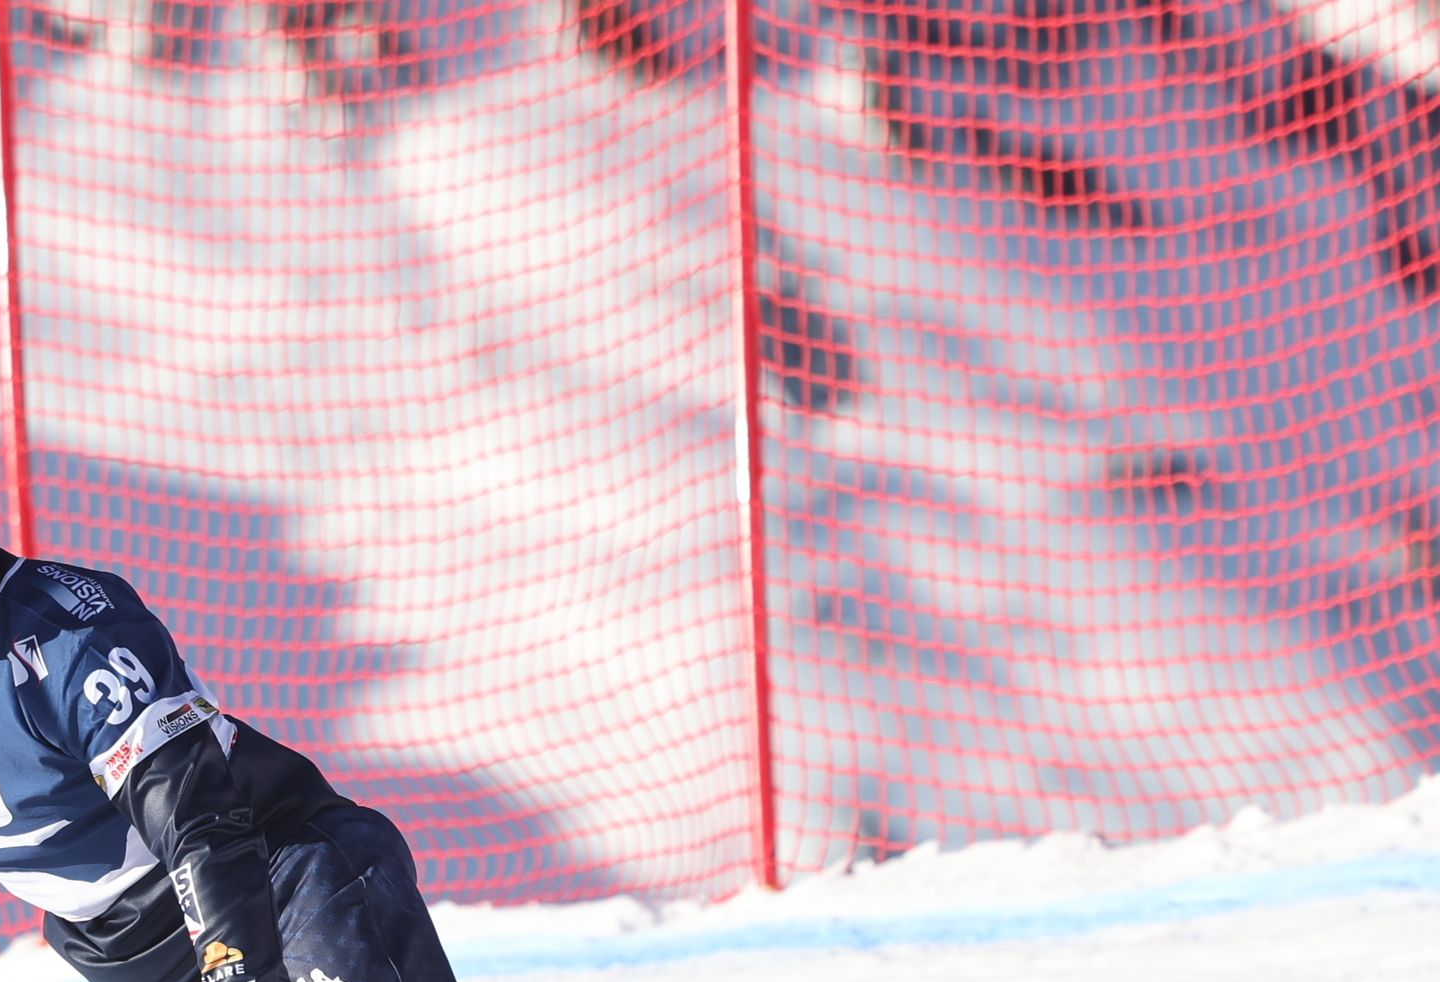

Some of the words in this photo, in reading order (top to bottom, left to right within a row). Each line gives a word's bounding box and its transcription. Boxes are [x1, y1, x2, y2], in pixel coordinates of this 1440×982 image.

[37, 565, 107, 614] VISIONS
[71, 602, 97, 621] IN
[83, 646, 158, 725] 39
[157, 716, 169, 729] IN
[161, 710, 199, 735] VISIONS
